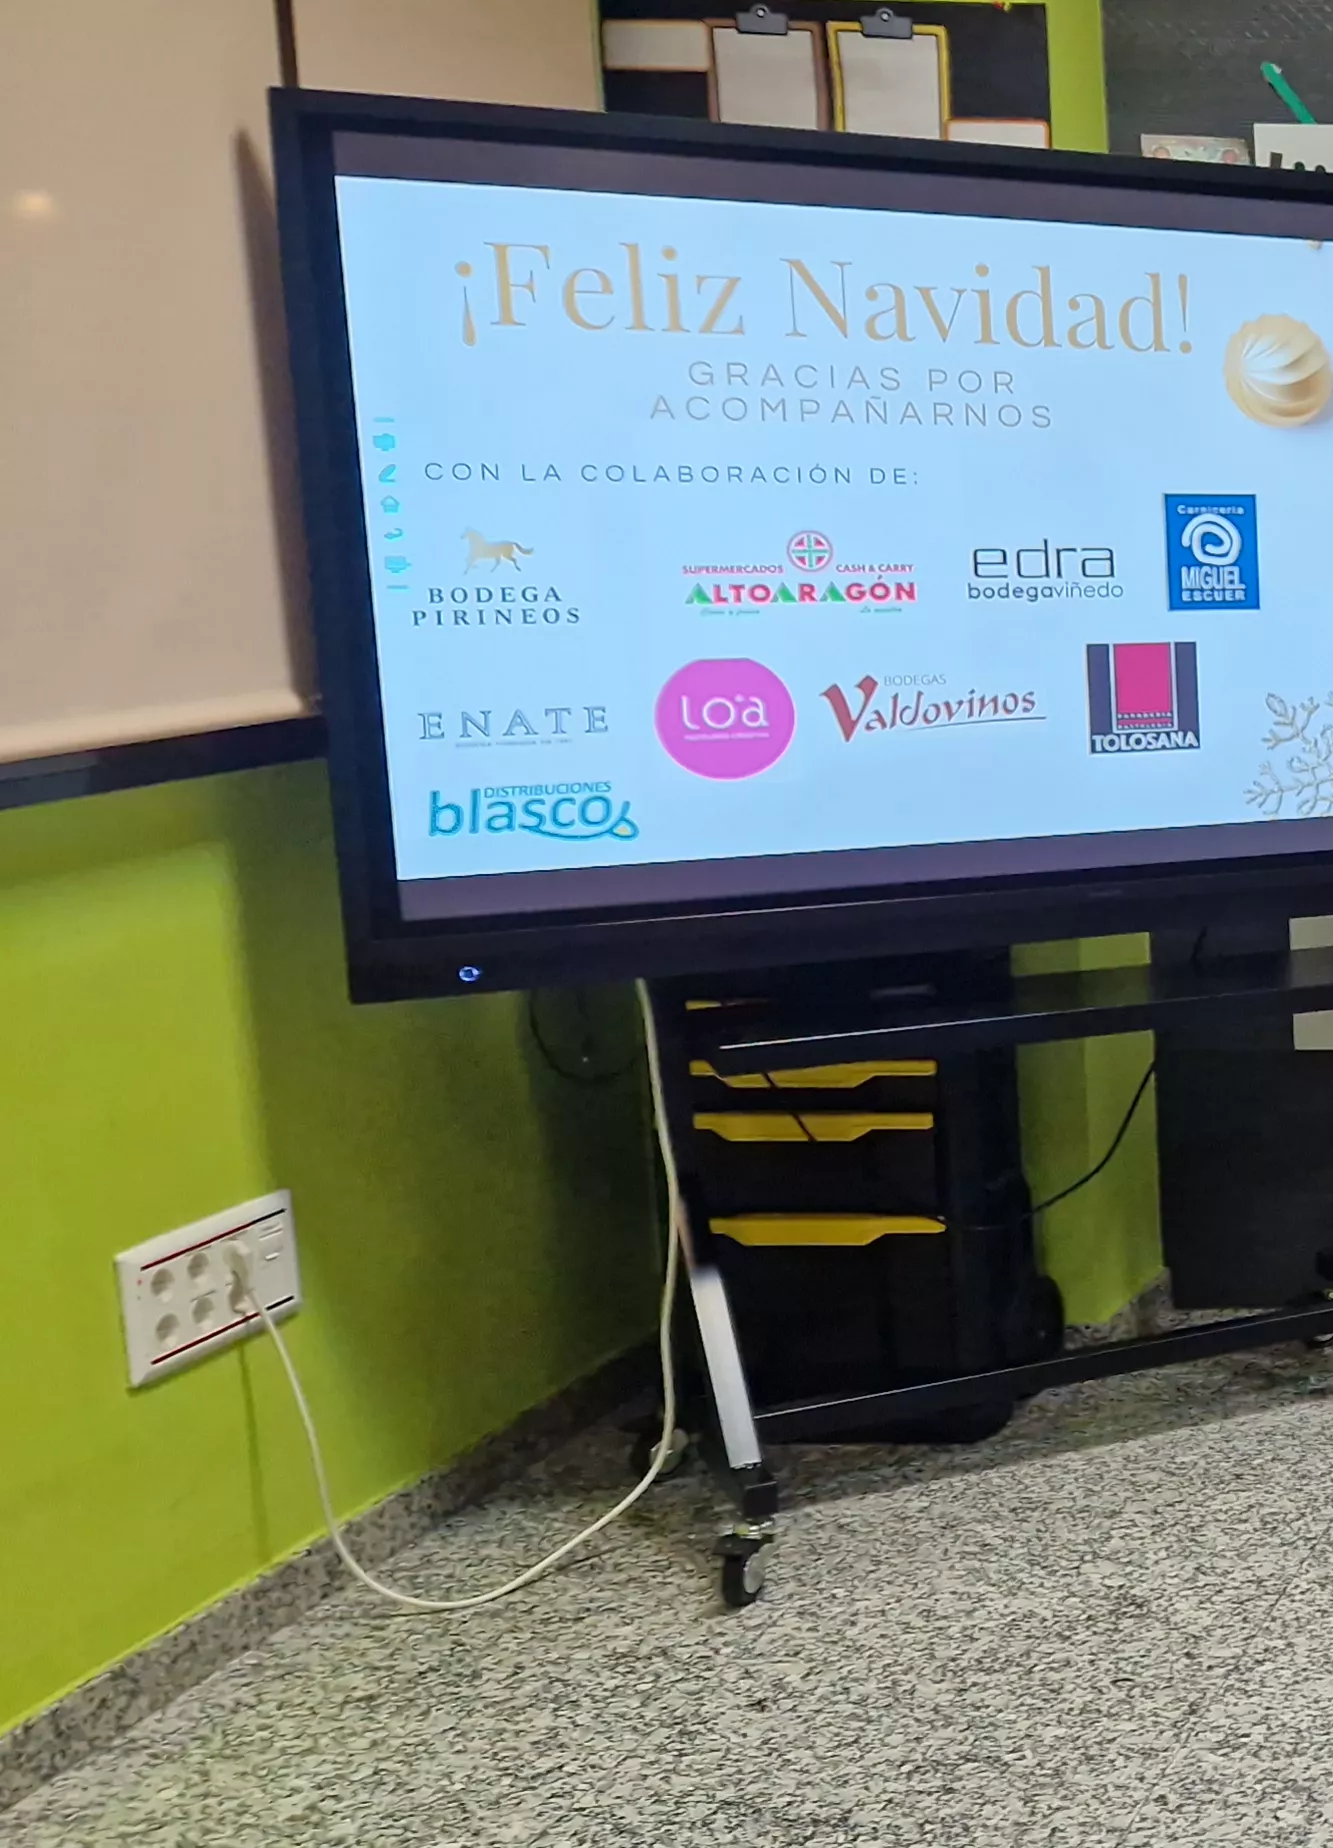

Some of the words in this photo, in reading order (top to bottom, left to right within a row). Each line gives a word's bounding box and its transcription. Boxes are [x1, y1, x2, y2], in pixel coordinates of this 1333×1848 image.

[454, 241, 745, 347] ¡Feliz
[781, 258, 1194, 355] Navidad!
[688, 360, 902, 393] GRACIAS
[928, 369, 1016, 396] POR
[650, 395, 1053, 430] ACOMPAÑARNOS
[424, 462, 501, 482] CON
[521, 463, 562, 482] LA
[581, 462, 852, 486] COLABORACIÓN
[870, 467, 920, 486] DE:
[682, 564, 784, 574] SUPERMERCADOS
[836, 564, 866, 573] CASH
[868, 564, 876, 572] &
[878, 563, 914, 573] CARRY
[973, 539, 1116, 579] edra
[685, 574, 917, 604] ALTOARAGÓN
[1181, 565, 1246, 589] MIGUEL
[428, 586, 563, 604] BODEGA
[968, 580, 1124, 602] bodegaviñedo
[1181, 590, 1246, 601] ESCUER
[412, 606, 581, 627] PIRINEOS
[884, 674, 947, 686] BODEGAS
[819, 675, 1036, 743] Valdovinos
[418, 706, 609, 740] ENATE
[1092, 731, 1199, 752] TOLOSANA
[484, 781, 612, 798] DISTRIBUCIONES
[428, 788, 614, 837] blasco
